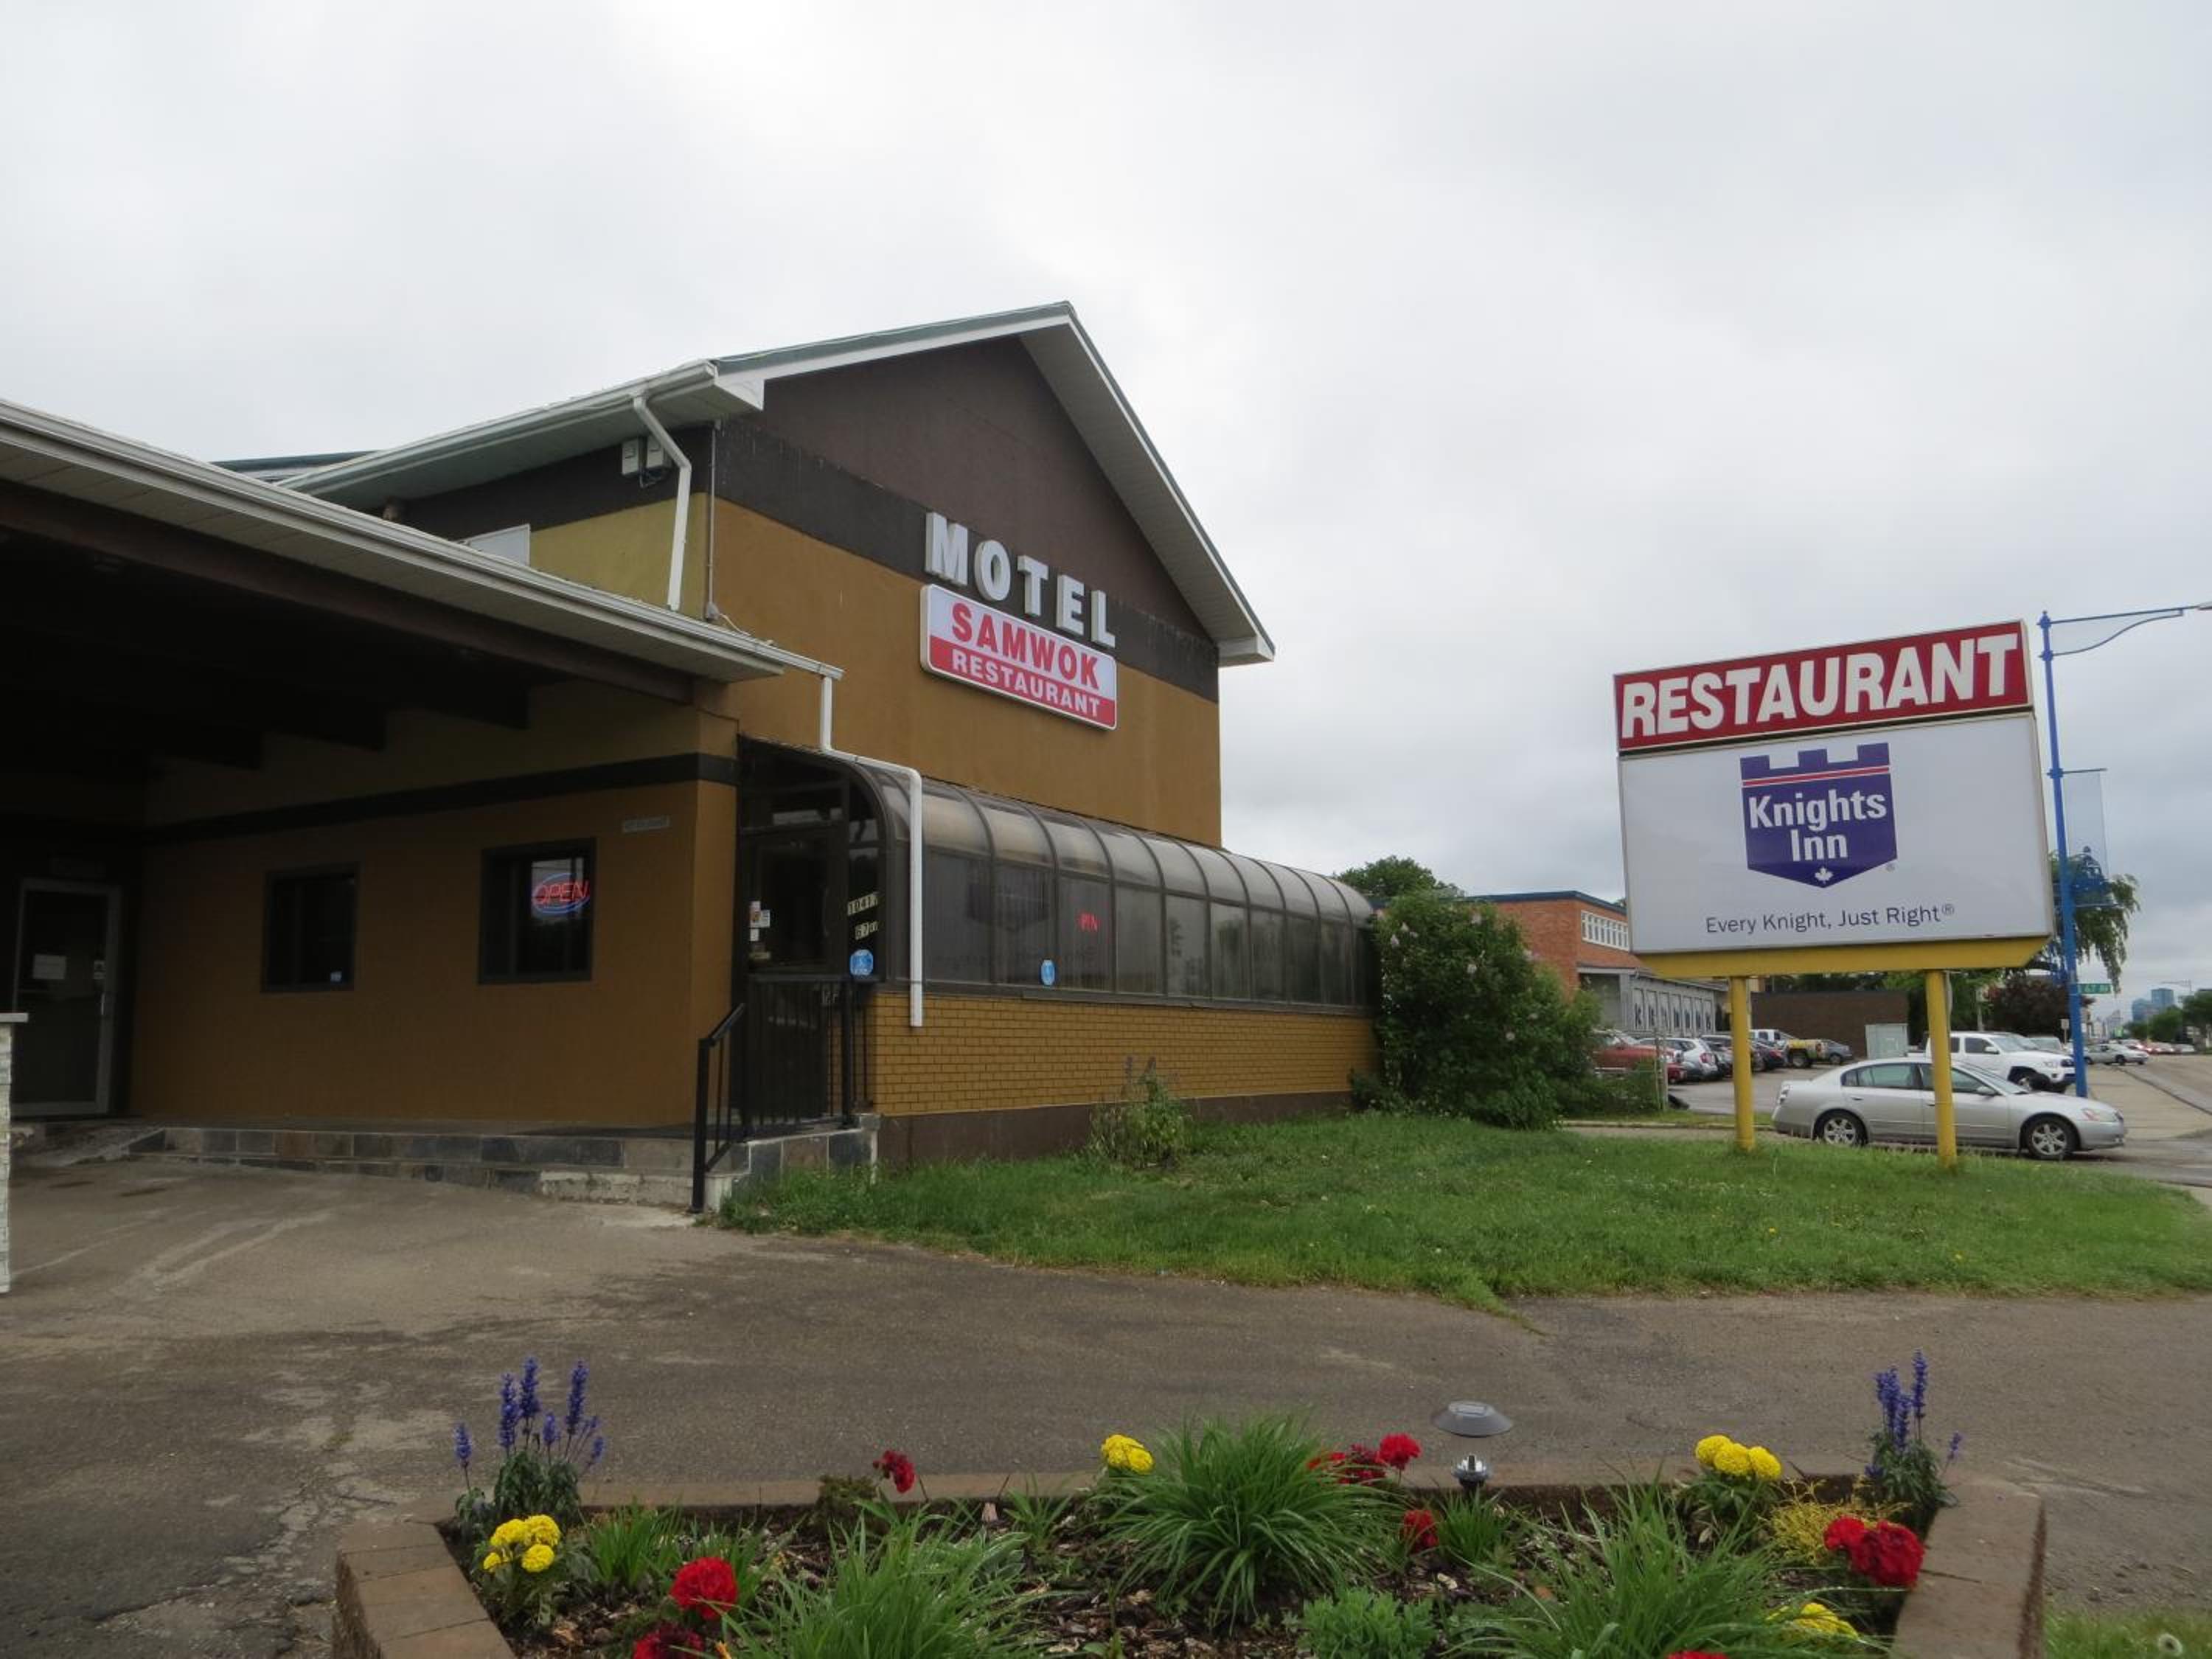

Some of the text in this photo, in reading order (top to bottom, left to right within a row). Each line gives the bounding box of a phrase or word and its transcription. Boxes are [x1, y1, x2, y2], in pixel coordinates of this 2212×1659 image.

[925, 512, 1116, 649] MOTEL
[951, 601, 1100, 691] SAMWOK
[951, 648, 1101, 717] RESTAURANT
[1622, 633, 2018, 739] RESTAURANT
[1748, 788, 1888, 832] Knights
[1790, 829, 1848, 862] Inn
[1705, 917, 1756, 935] Every
[1762, 912, 1832, 933] Knight,
[1838, 910, 1879, 927] Just
